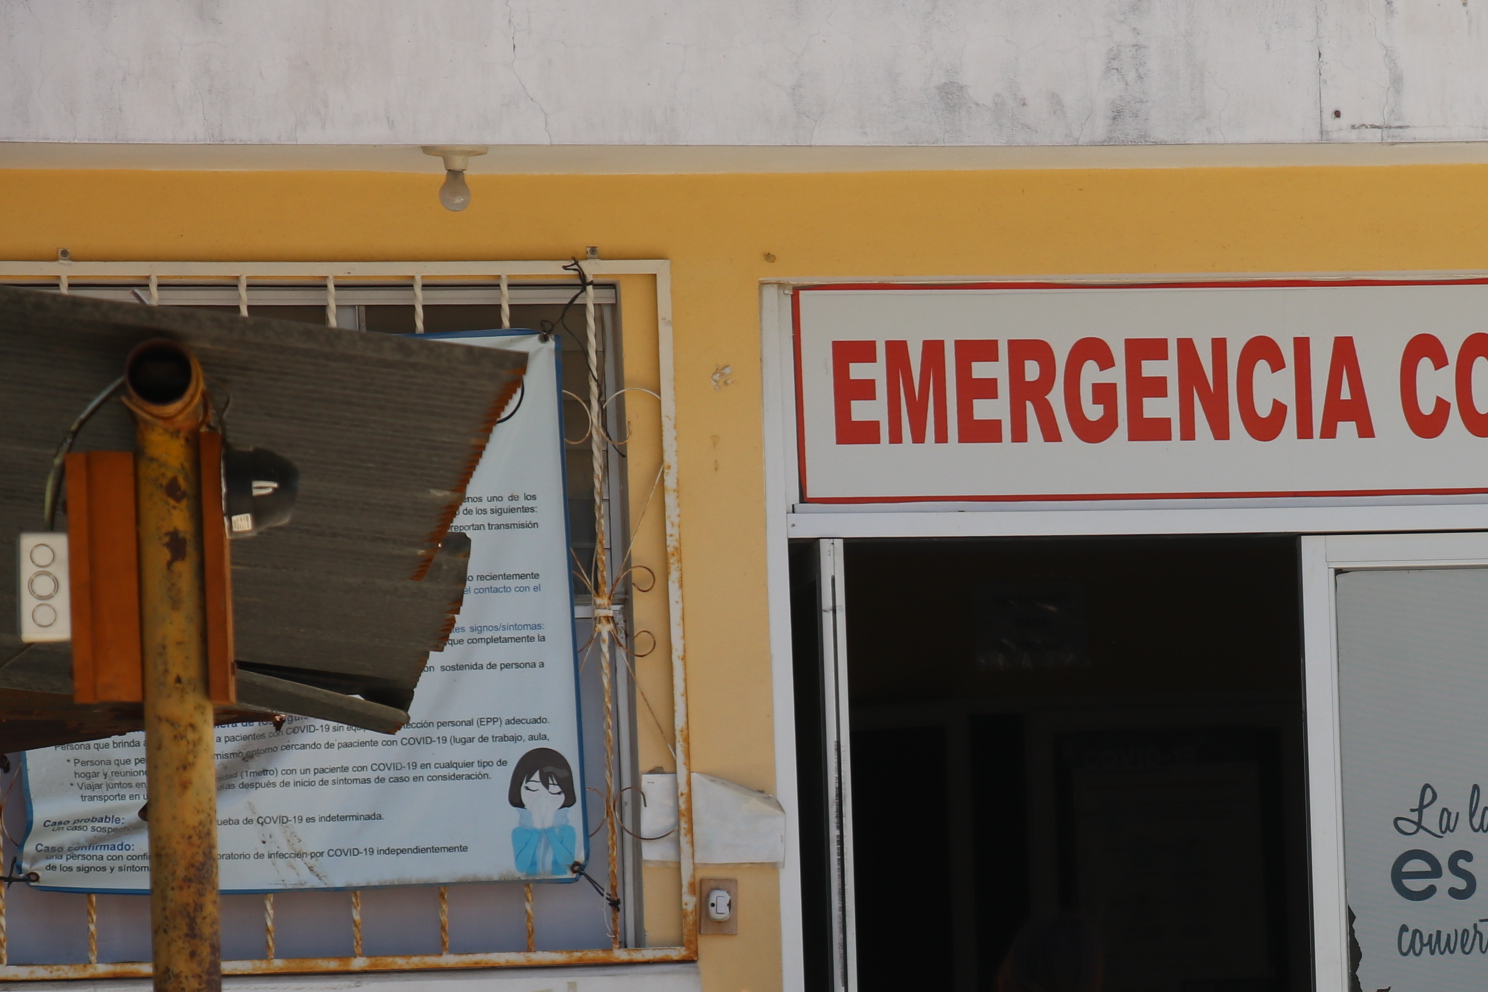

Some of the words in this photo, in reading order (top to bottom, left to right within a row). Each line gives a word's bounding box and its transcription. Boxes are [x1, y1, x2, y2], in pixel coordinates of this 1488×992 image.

[831, 334, 1375, 446] EMERGENCIA
[490, 506, 537, 516] siguientes:
[487, 521, 539, 530] transmisión
[476, 572, 539, 581] recientemente
[474, 584, 511, 594] contacto
[514, 585, 530, 593] con
[467, 635, 535, 645] completamente
[440, 662, 484, 672] sostenida
[500, 662, 536, 671] persona
[436, 719, 474, 730] personal
[477, 717, 502, 728] (EPP)
[504, 716, 550, 726] adecuado.
[224, 732, 266, 744] pacientes
[286, 724, 330, 735] COVID-19
[112, 739, 140, 749] brinda
[381, 738, 398, 747] con
[401, 736, 447, 746] COVID-19
[450, 736, 475, 745] (lugar
[492, 734, 525, 743] trabajo,
[528, 733, 550, 742] aula,
[280, 742, 322, 752] cercando
[337, 739, 379, 750] paaciente
[73, 758, 111, 767] Persona
[114, 758, 131, 767] que
[371, 761, 417, 772] COVID-19
[434, 760, 475, 771] cualquier
[477, 760, 494, 769] tipo
[74, 770, 100, 780] hogar
[281, 768, 297, 776] con
[313, 765, 349, 777] paciente
[388, 775, 409, 783] caso
[427, 772, 491, 782] consideración.
[77, 782, 103, 791] Viajar
[106, 781, 133, 791] juntos
[239, 780, 277, 790] después
[293, 778, 316, 787] inicio
[332, 776, 372, 786] síntomas
[81, 793, 126, 803] transporte
[1393, 783, 1460, 839] La
[73, 815, 125, 825] probable:
[256, 814, 303, 826] COVID-19
[318, 812, 384, 823] indeterminada.
[35, 843, 63, 853] Caso
[67, 842, 135, 852] confirmado:
[328, 847, 374, 858] COVID-19
[377, 844, 468, 856] independientemente
[66, 853, 103, 862] persona
[76, 864, 106, 874] signos
[1390, 848, 1477, 902] es
